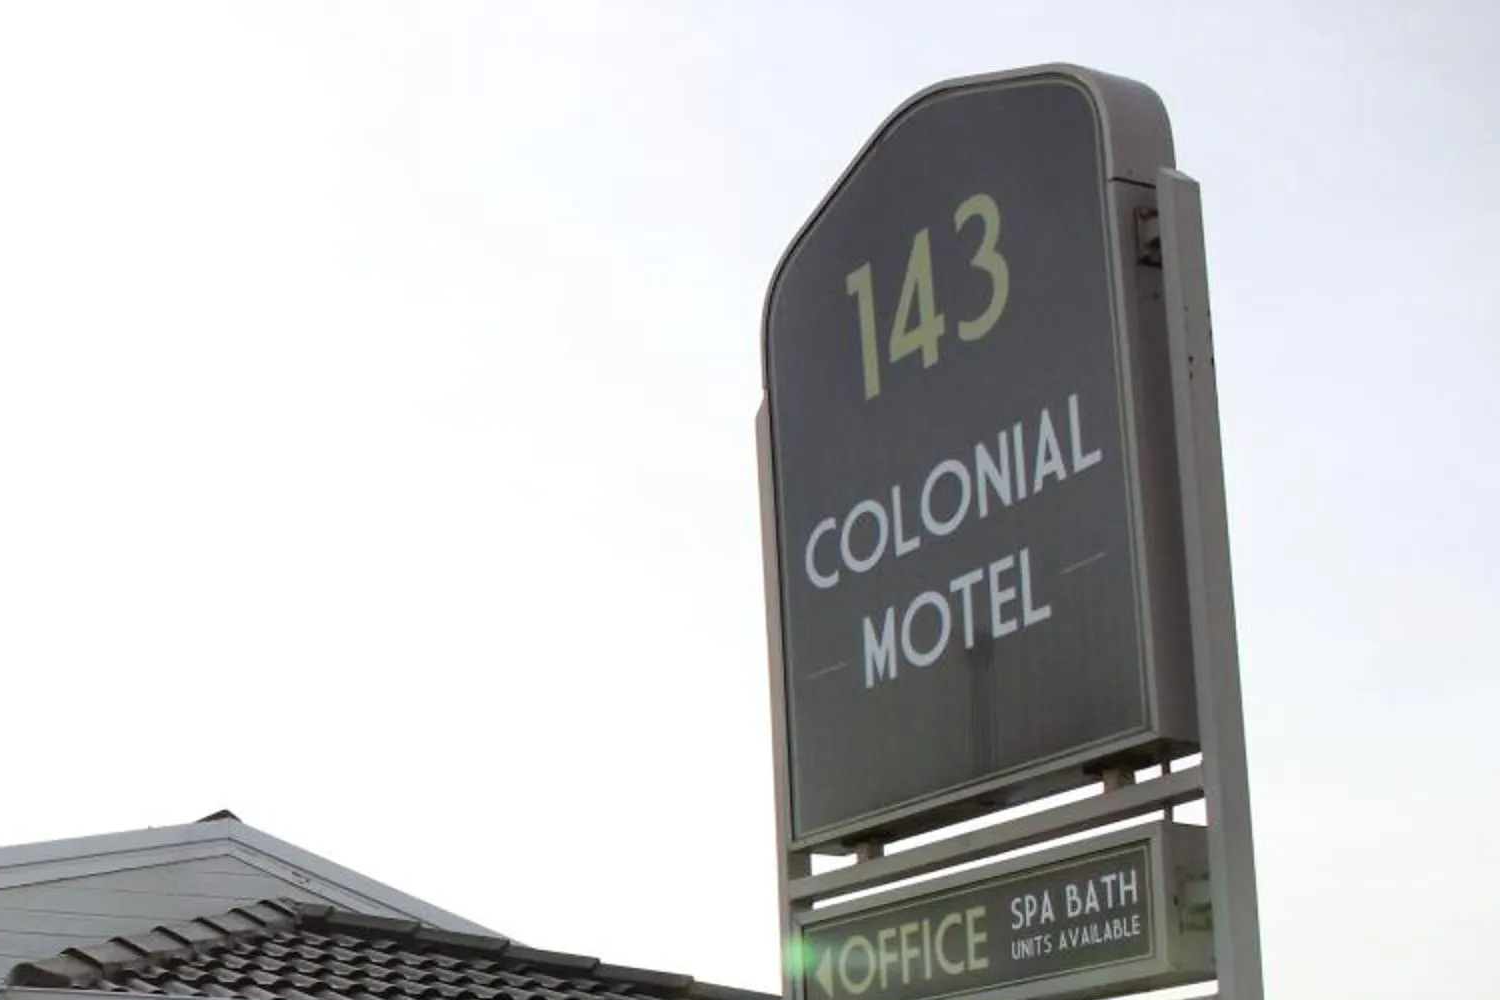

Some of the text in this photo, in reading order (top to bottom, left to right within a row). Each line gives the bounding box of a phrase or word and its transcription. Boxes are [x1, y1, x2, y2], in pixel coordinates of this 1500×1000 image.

[845, 192, 1010, 401] 143
[804, 393, 1102, 590] COLONIAL
[862, 547, 1052, 689] MOTEL
[838, 906, 989, 995] OFFICE
[1010, 868, 1137, 930] SPA BATH
[1011, 914, 1141, 961] UNITS AVAILABLE
